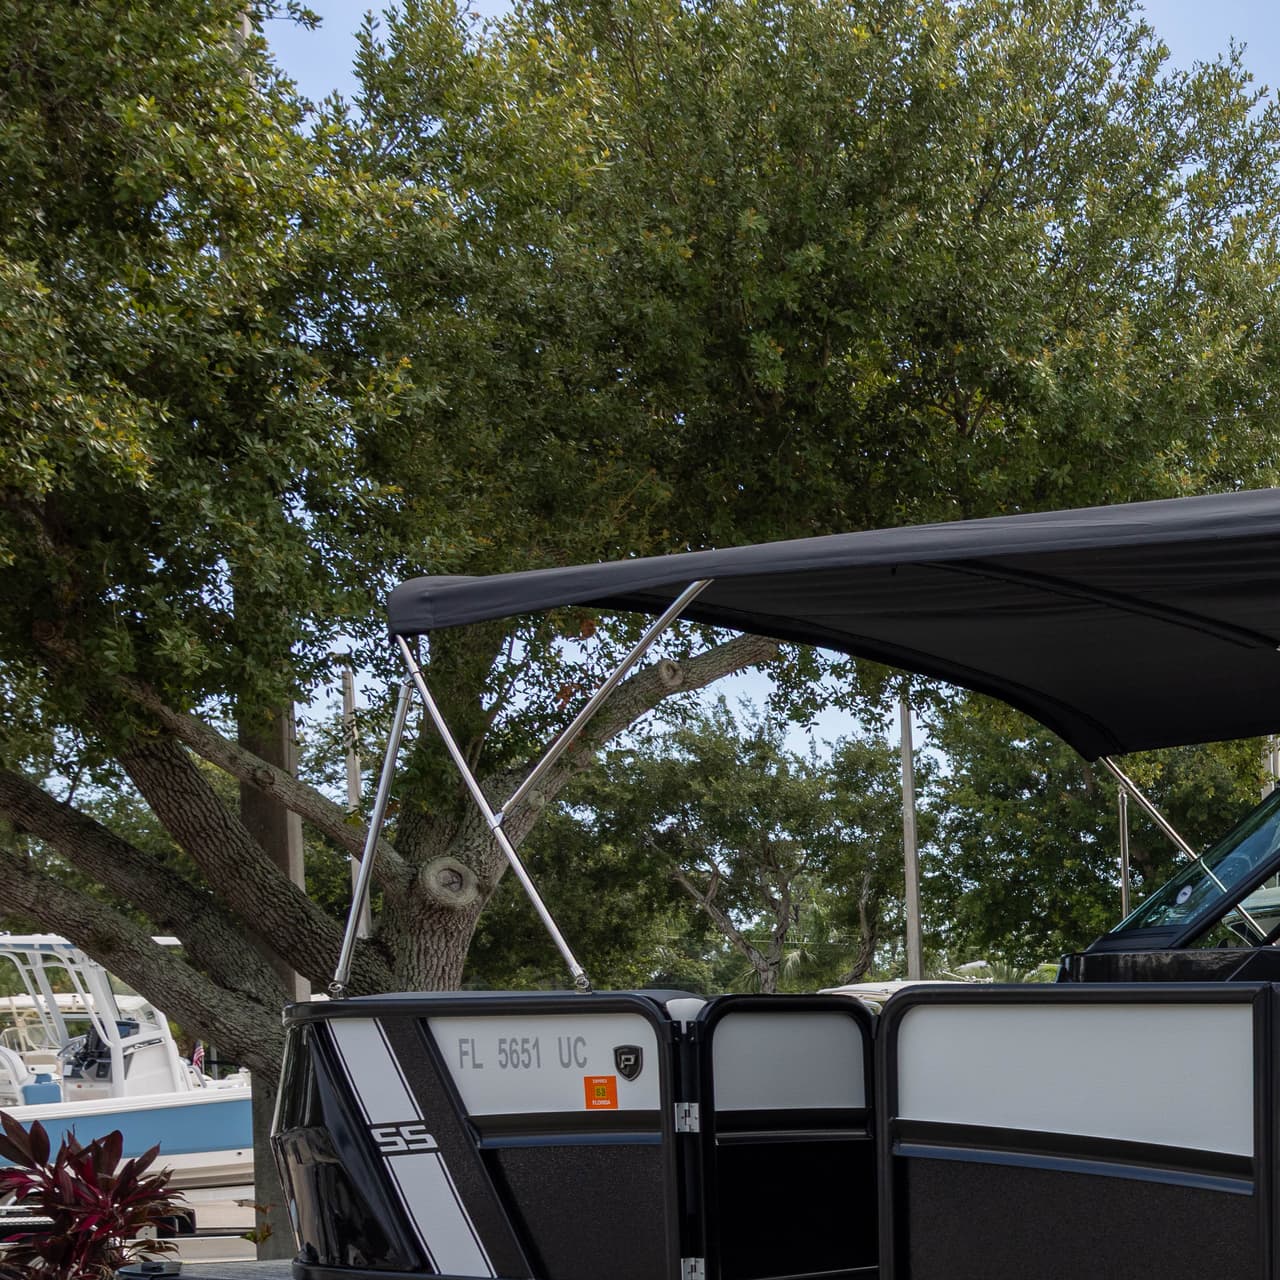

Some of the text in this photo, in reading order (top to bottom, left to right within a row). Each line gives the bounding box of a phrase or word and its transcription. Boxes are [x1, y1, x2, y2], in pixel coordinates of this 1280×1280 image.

[458, 1036, 588, 1070] FL 5651 UC
[371, 1124, 438, 1152] SS
